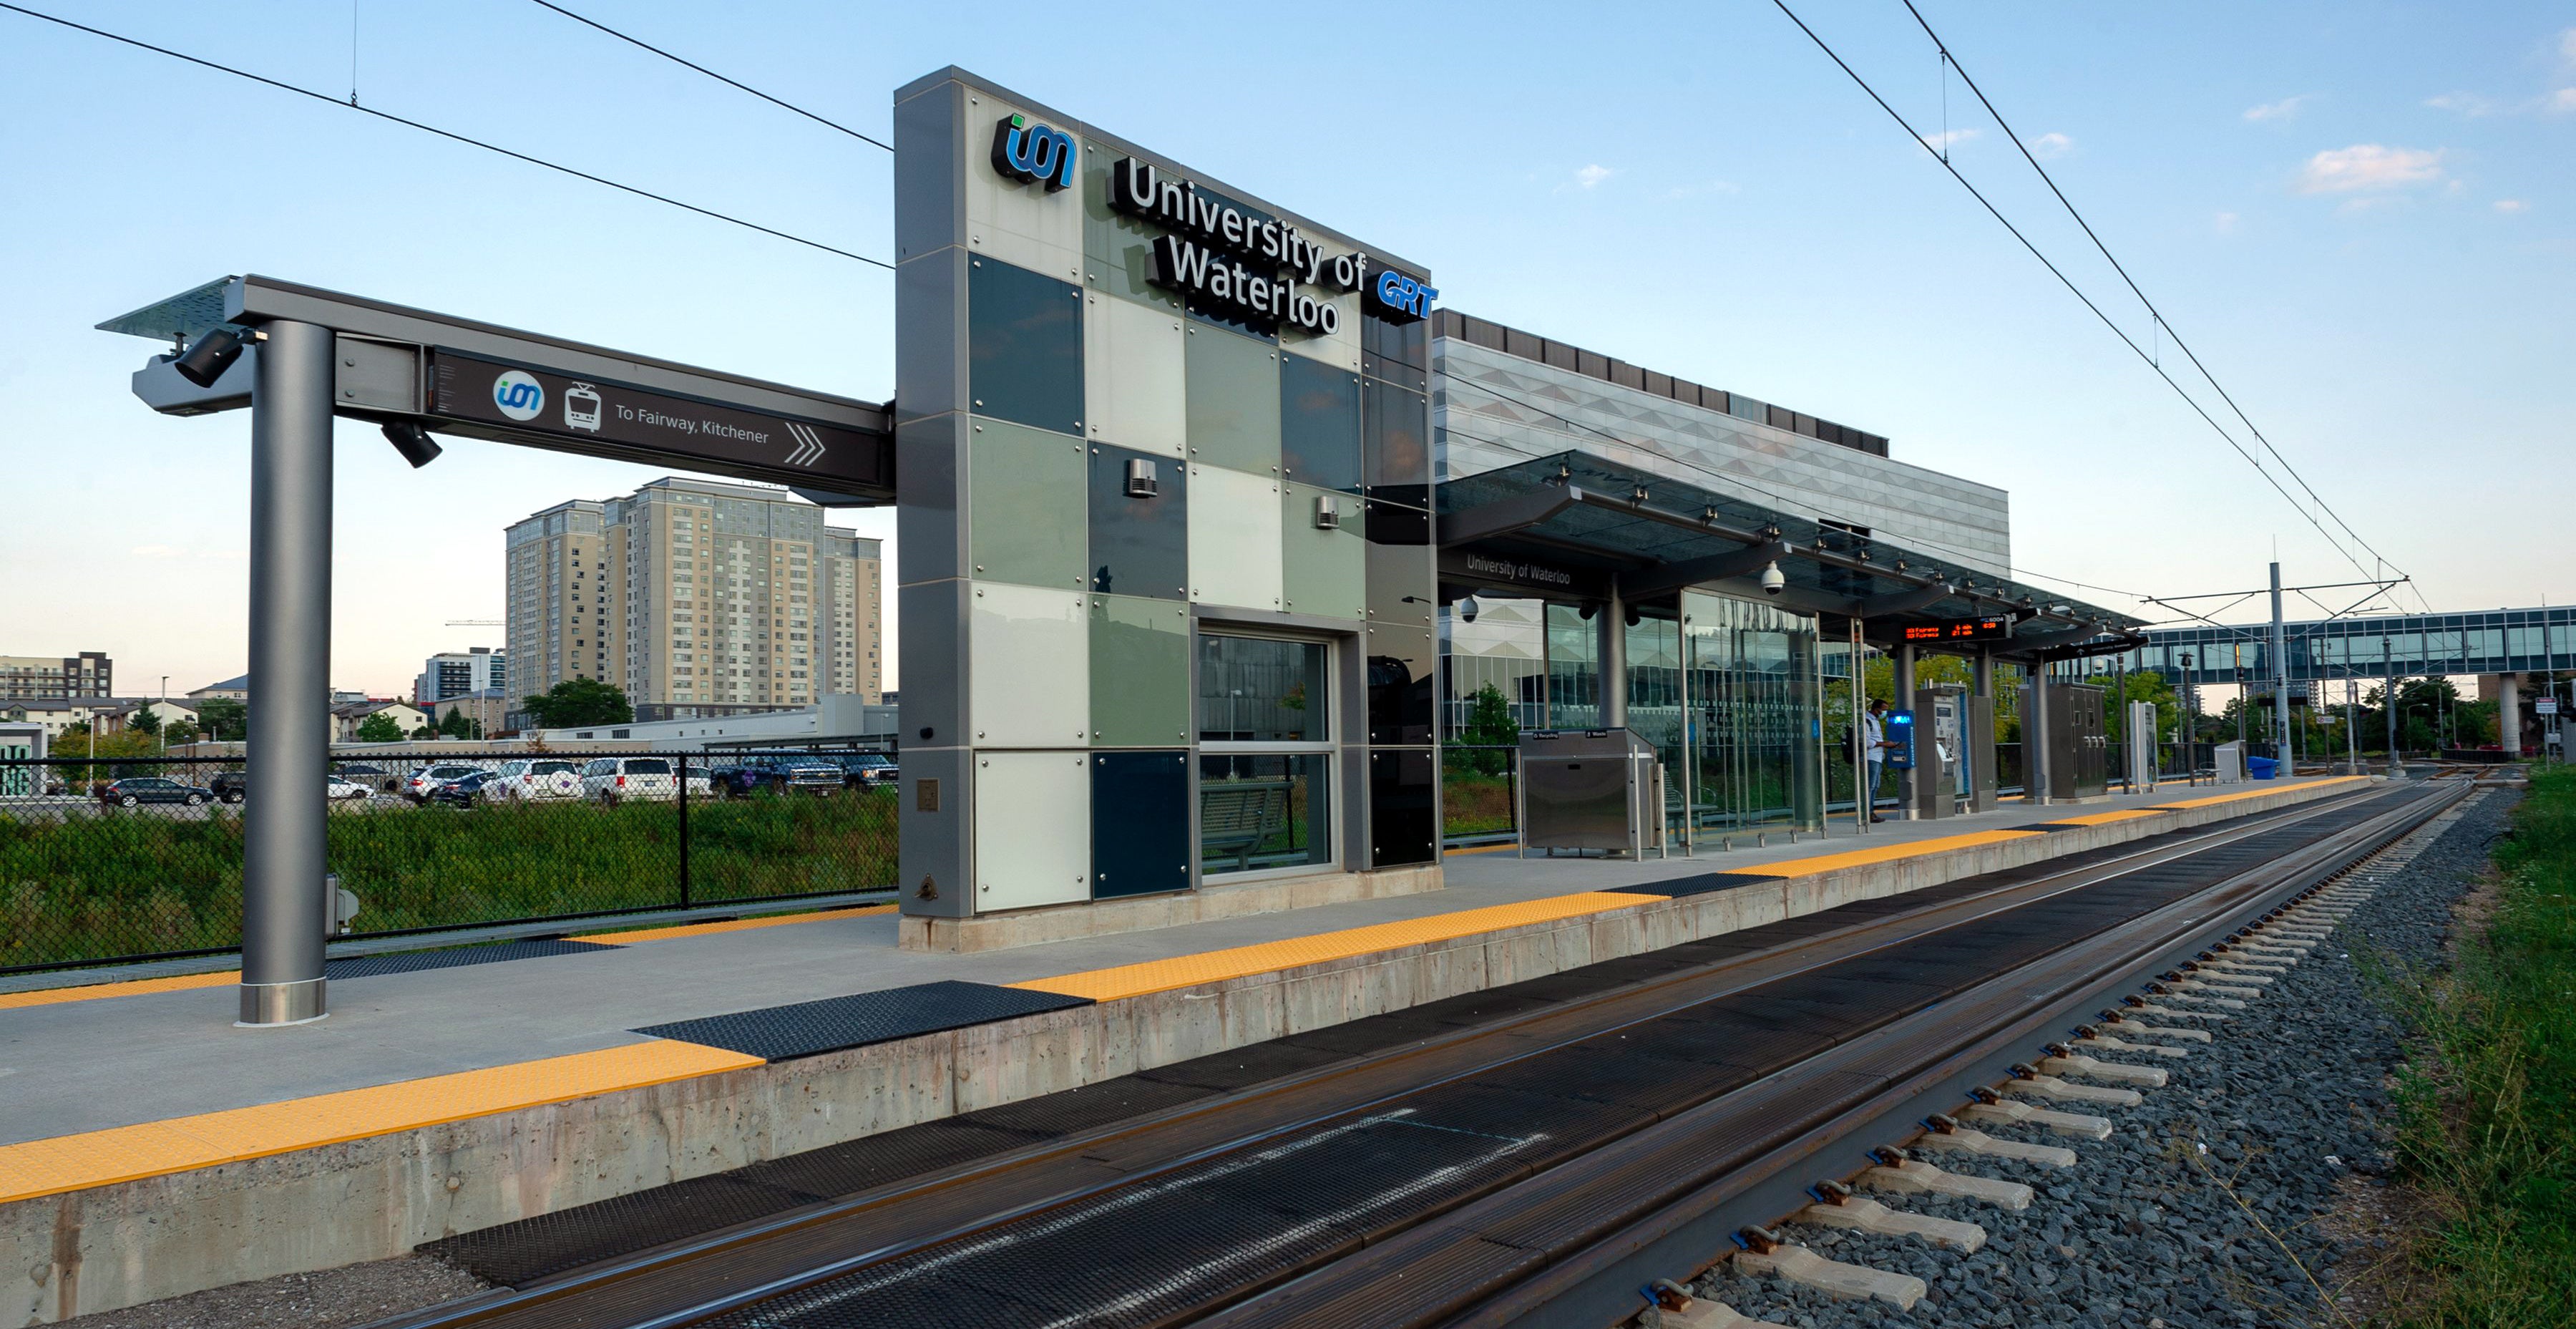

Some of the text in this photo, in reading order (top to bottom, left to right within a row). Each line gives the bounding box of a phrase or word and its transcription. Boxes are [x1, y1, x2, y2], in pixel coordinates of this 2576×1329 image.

[1128, 156, 1366, 291] University of
[1167, 234, 1340, 335] Waterloo
[1377, 270, 1439, 320] GRT
[616, 404, 769, 444] To Fairway, Kitchener
[1467, 554, 1571, 585] University of Waterloo
